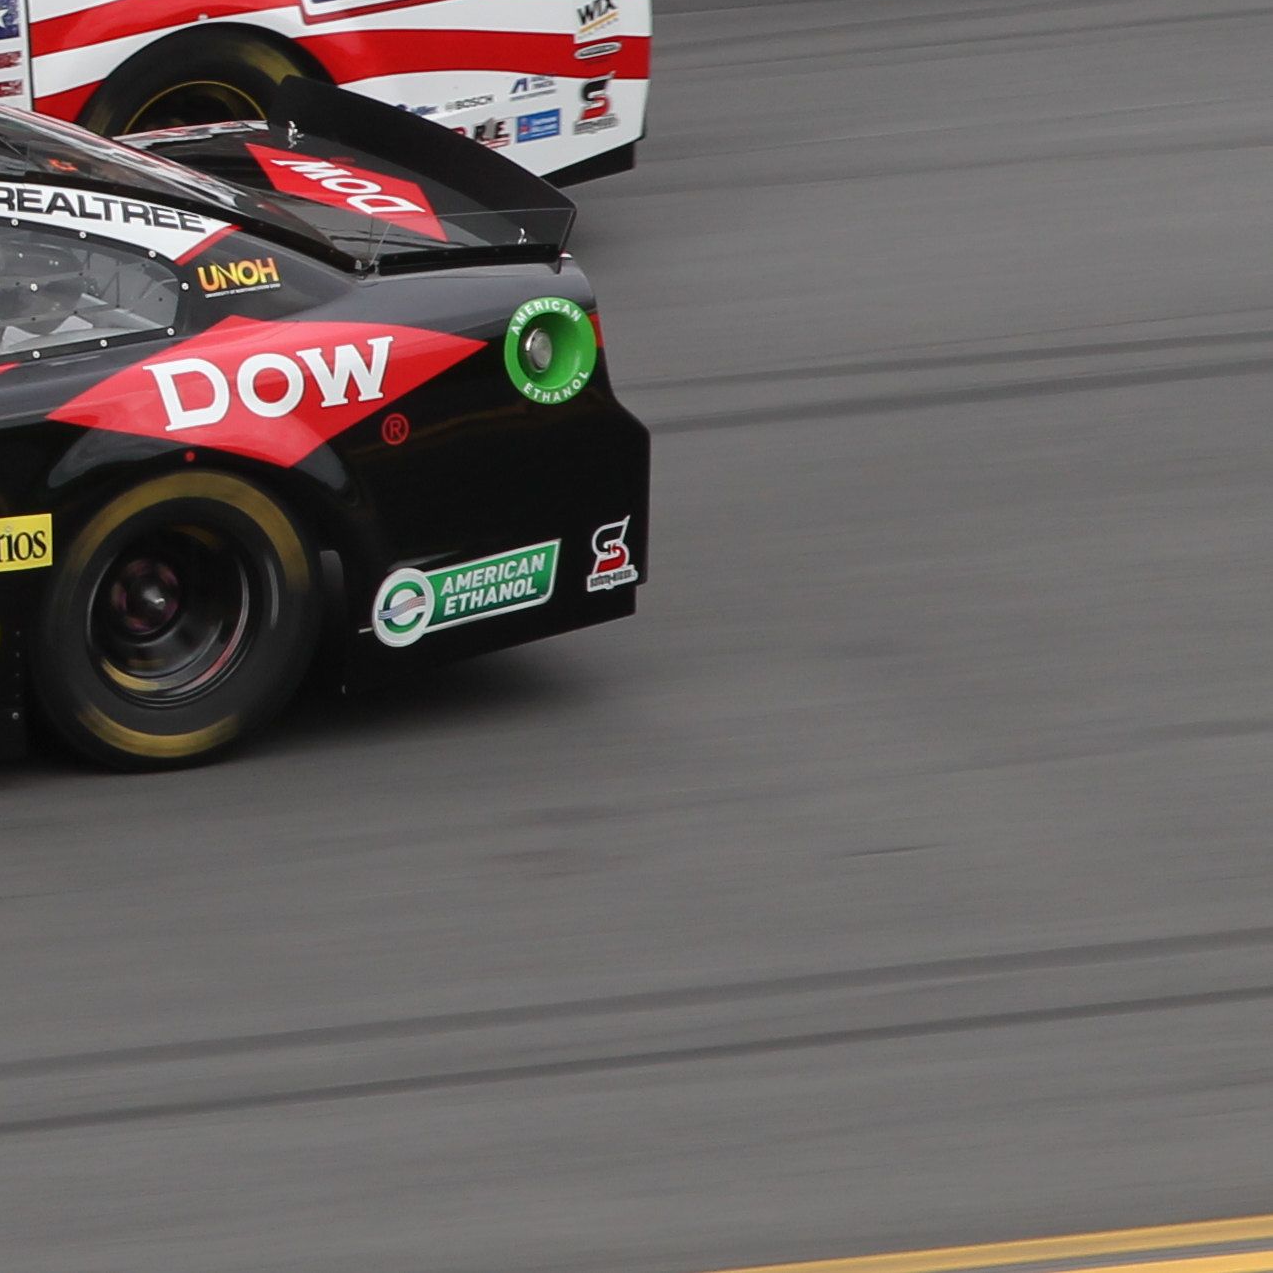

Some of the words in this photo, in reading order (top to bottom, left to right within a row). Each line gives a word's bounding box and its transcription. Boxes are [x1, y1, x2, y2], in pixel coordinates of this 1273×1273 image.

[269, 158, 426, 215] DOW
[196, 257, 280, 292] UNOH
[511, 299, 582, 336] AMERICAN
[142, 336, 394, 432] DOW
[522, 370, 590, 403] ETHANOL
[439, 552, 546, 596] AMERICAN
[442, 578, 538, 616] ETHANOL
